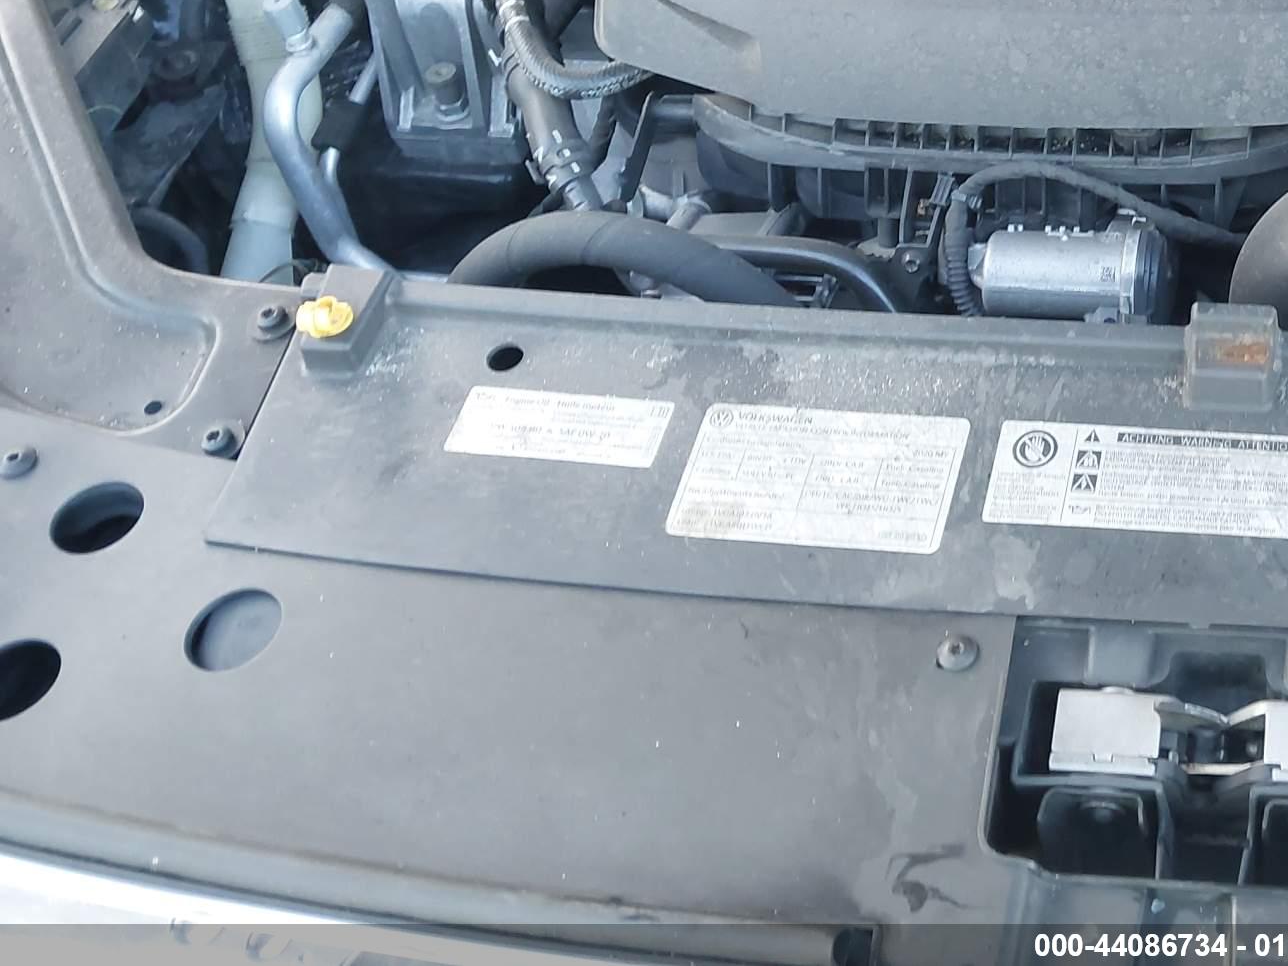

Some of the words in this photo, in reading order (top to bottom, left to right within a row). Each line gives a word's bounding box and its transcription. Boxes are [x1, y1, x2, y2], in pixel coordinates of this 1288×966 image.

[738, 411, 813, 425] VOLKSWAGEN
[1121, 433, 1174, 445] ACHTUNG
[1181, 435, 1231, 448] WARNING
